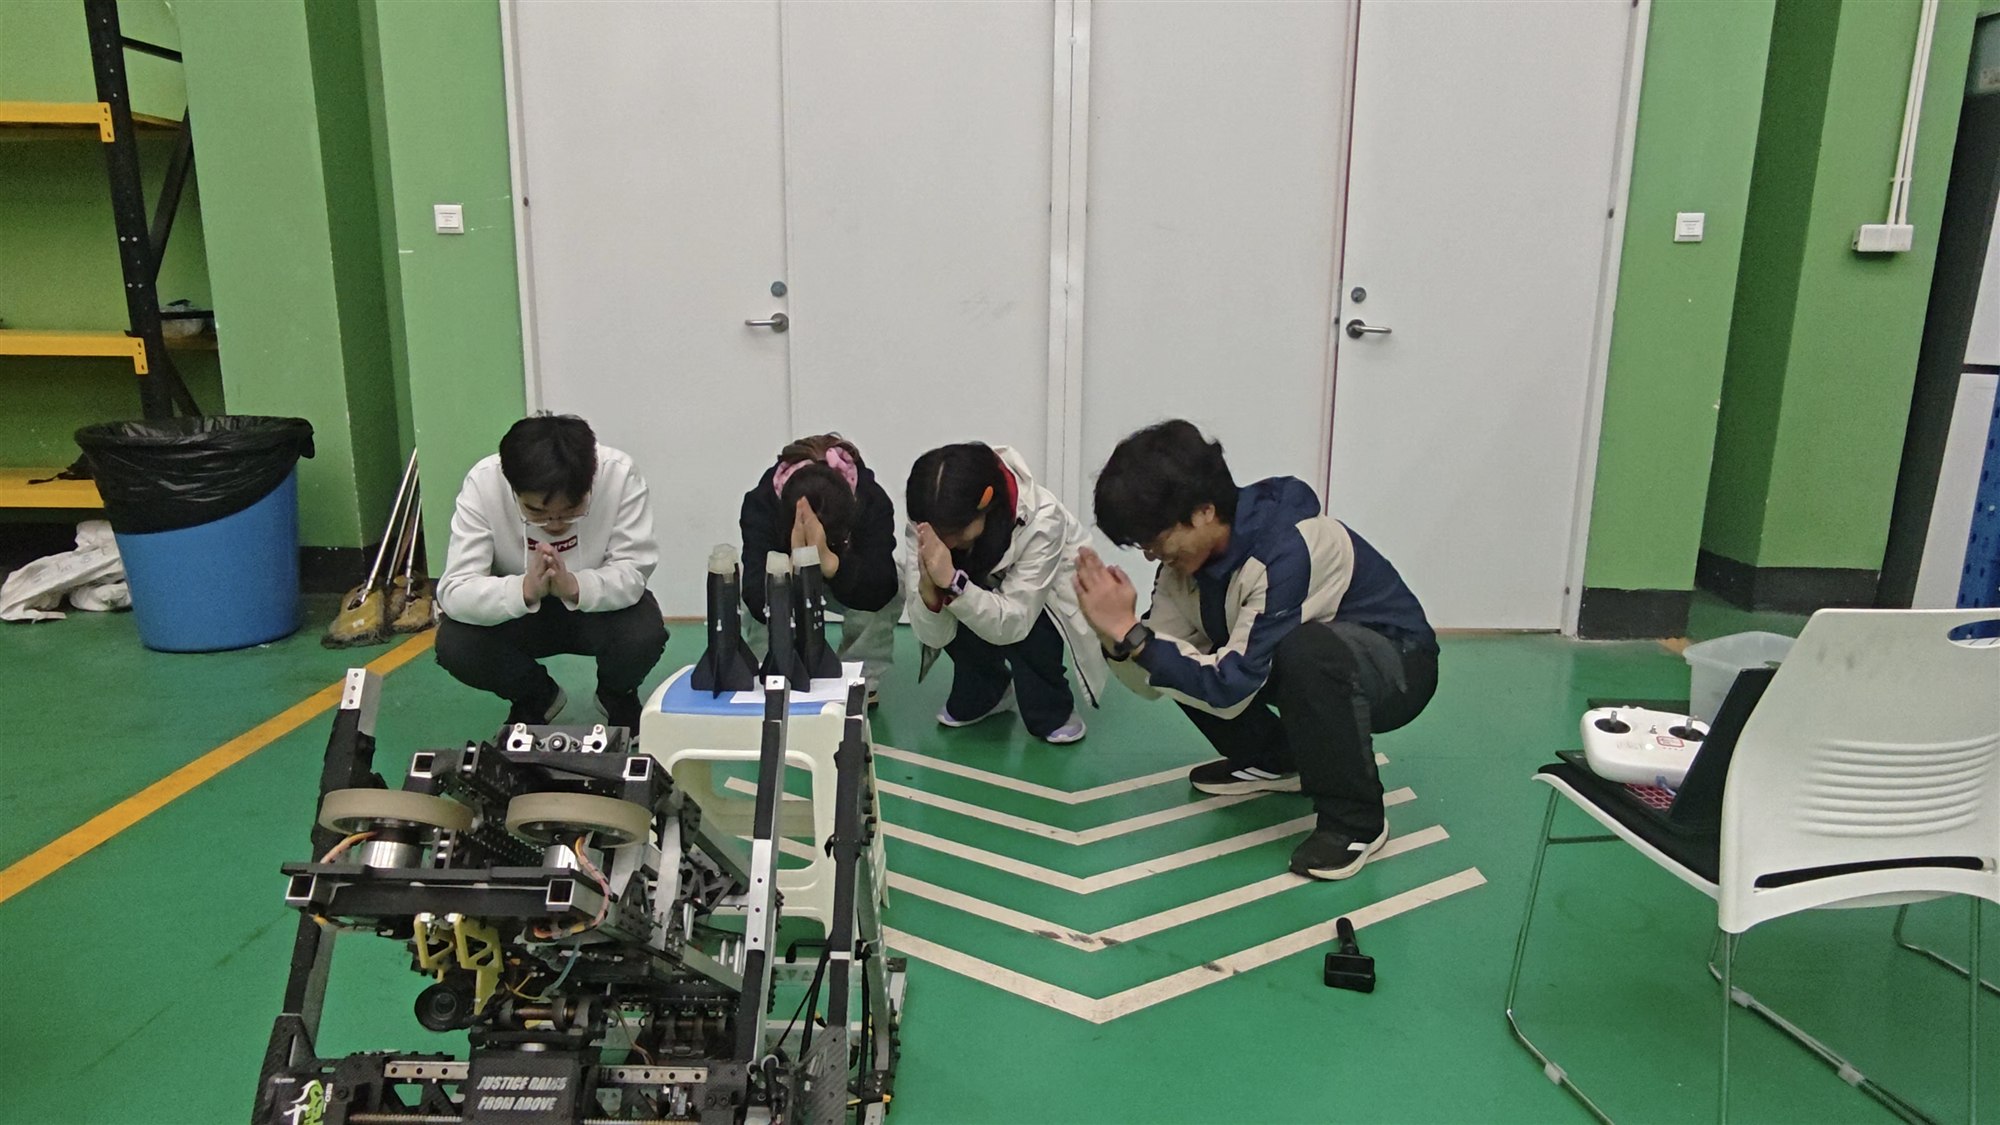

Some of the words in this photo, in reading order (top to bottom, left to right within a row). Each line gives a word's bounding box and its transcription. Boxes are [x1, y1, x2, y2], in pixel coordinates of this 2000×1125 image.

[477, 1076, 530, 1090] JUSTICE
[477, 1096, 516, 1111] FROM
[512, 1096, 558, 1111] ABOVE
